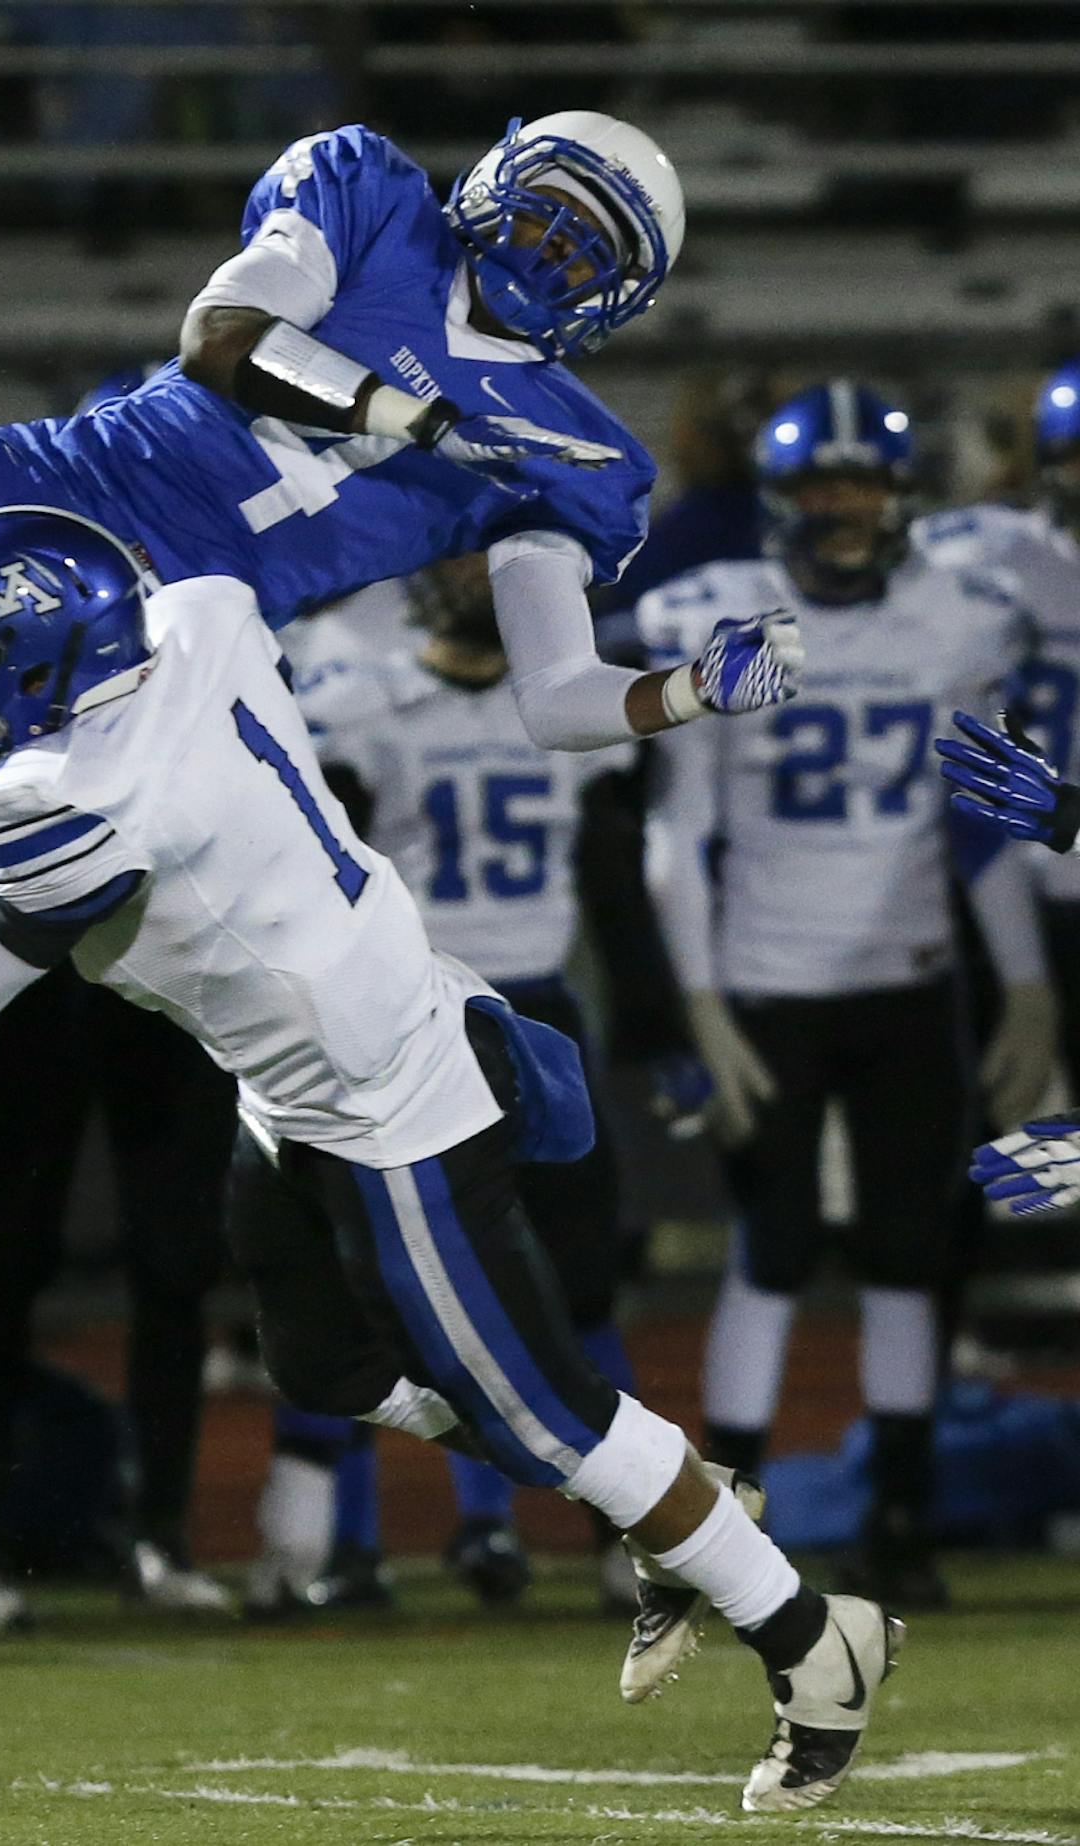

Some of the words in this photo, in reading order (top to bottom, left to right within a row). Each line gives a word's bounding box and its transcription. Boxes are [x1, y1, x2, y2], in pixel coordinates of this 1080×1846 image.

[230, 697, 370, 908] 1
[770, 702, 931, 820] 27
[423, 775, 551, 899] 15
